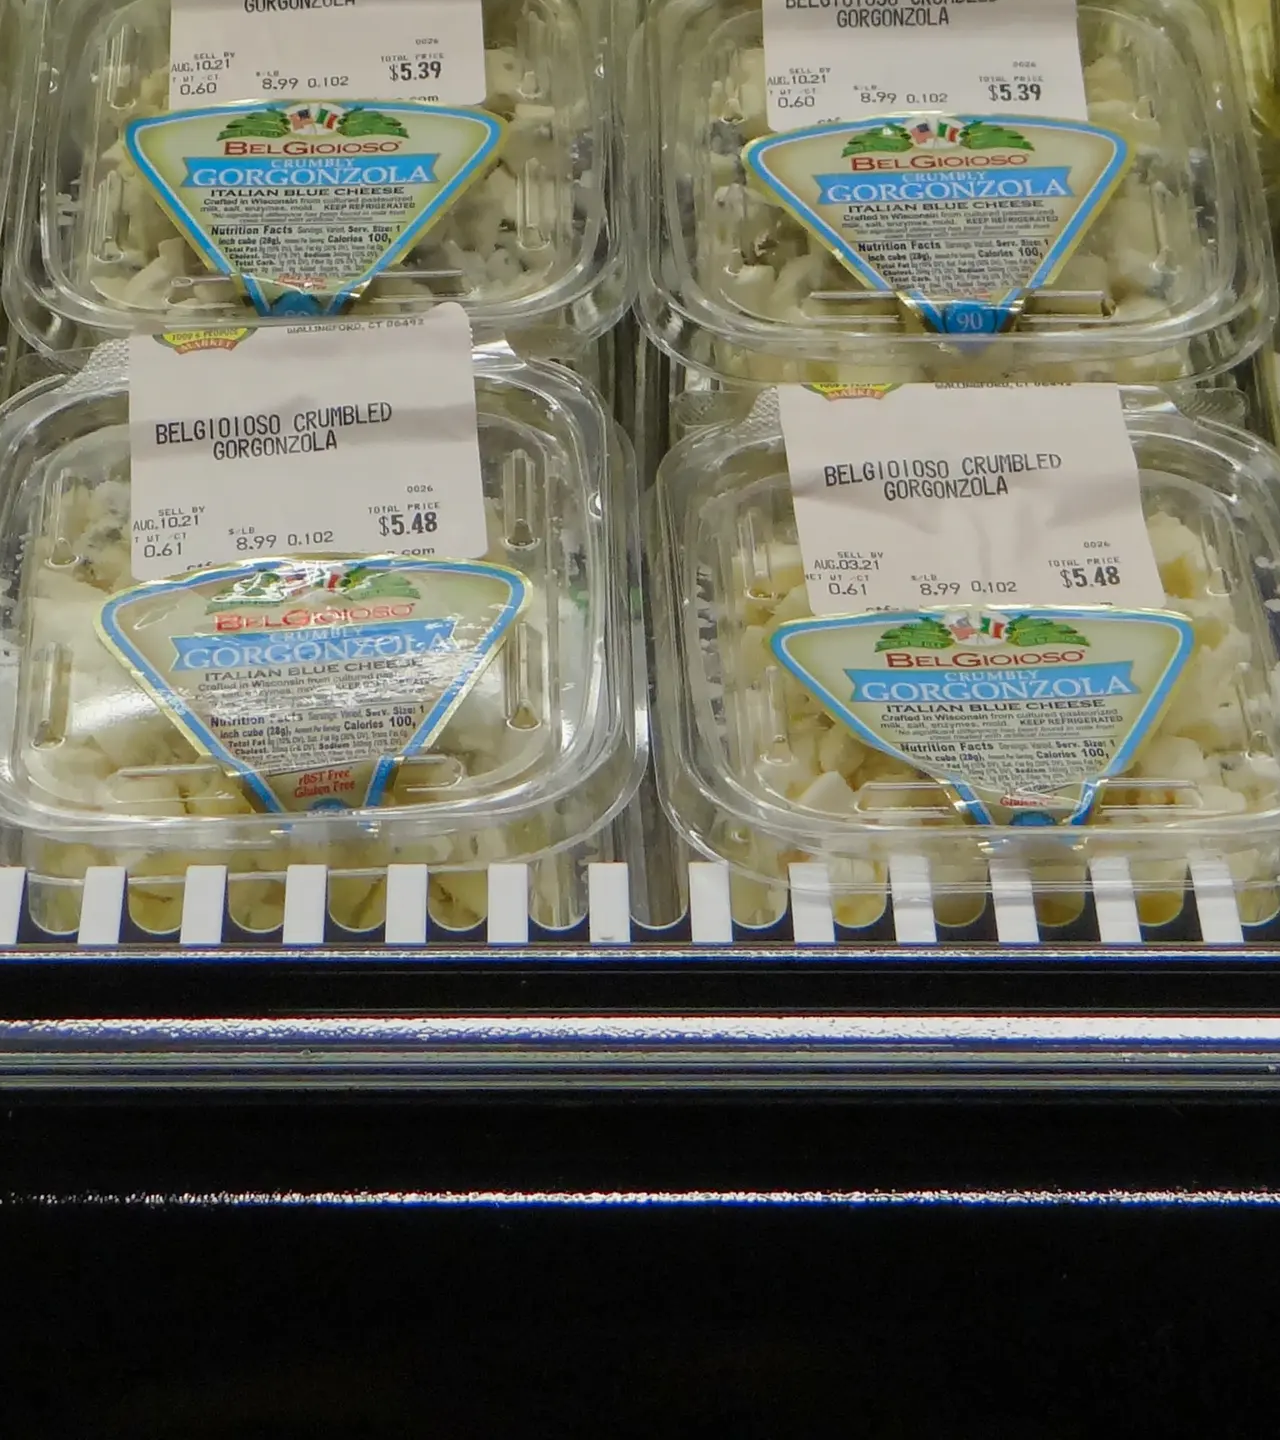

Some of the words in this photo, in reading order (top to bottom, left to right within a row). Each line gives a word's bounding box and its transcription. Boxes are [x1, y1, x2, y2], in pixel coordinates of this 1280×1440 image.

[836, 7, 949, 28] GORGONZOLA
[389, 61, 441, 81] $5.39
[988, 84, 1042, 102] $5.39
[270, 157, 355, 168] CRUMBLY
[192, 165, 430, 188] GORGONZOLA
[210, 188, 278, 198] ITALIAN
[284, 187, 329, 197] BLUE
[334, 185, 405, 196] CHEESE
[826, 179, 1068, 203] GORGONZOLA
[956, 310, 983, 331] 90
[155, 414, 281, 445] BELGIOIOSO
[293, 402, 392, 431] CRUMBLED
[213, 431, 338, 461] GORGONZOLA
[824, 458, 950, 487] BELGIOIOSO
[961, 453, 1062, 477] CRUMBLED
[406, 485, 434, 494] 0026
[883, 476, 1009, 501] GORGONZOLA
[378, 512, 438, 537] $5.48
[1060, 566, 1121, 590] $5.48
[944, 670, 1039, 682] CRUMBLY
[860, 676, 1131, 703] GORGONZOLA
